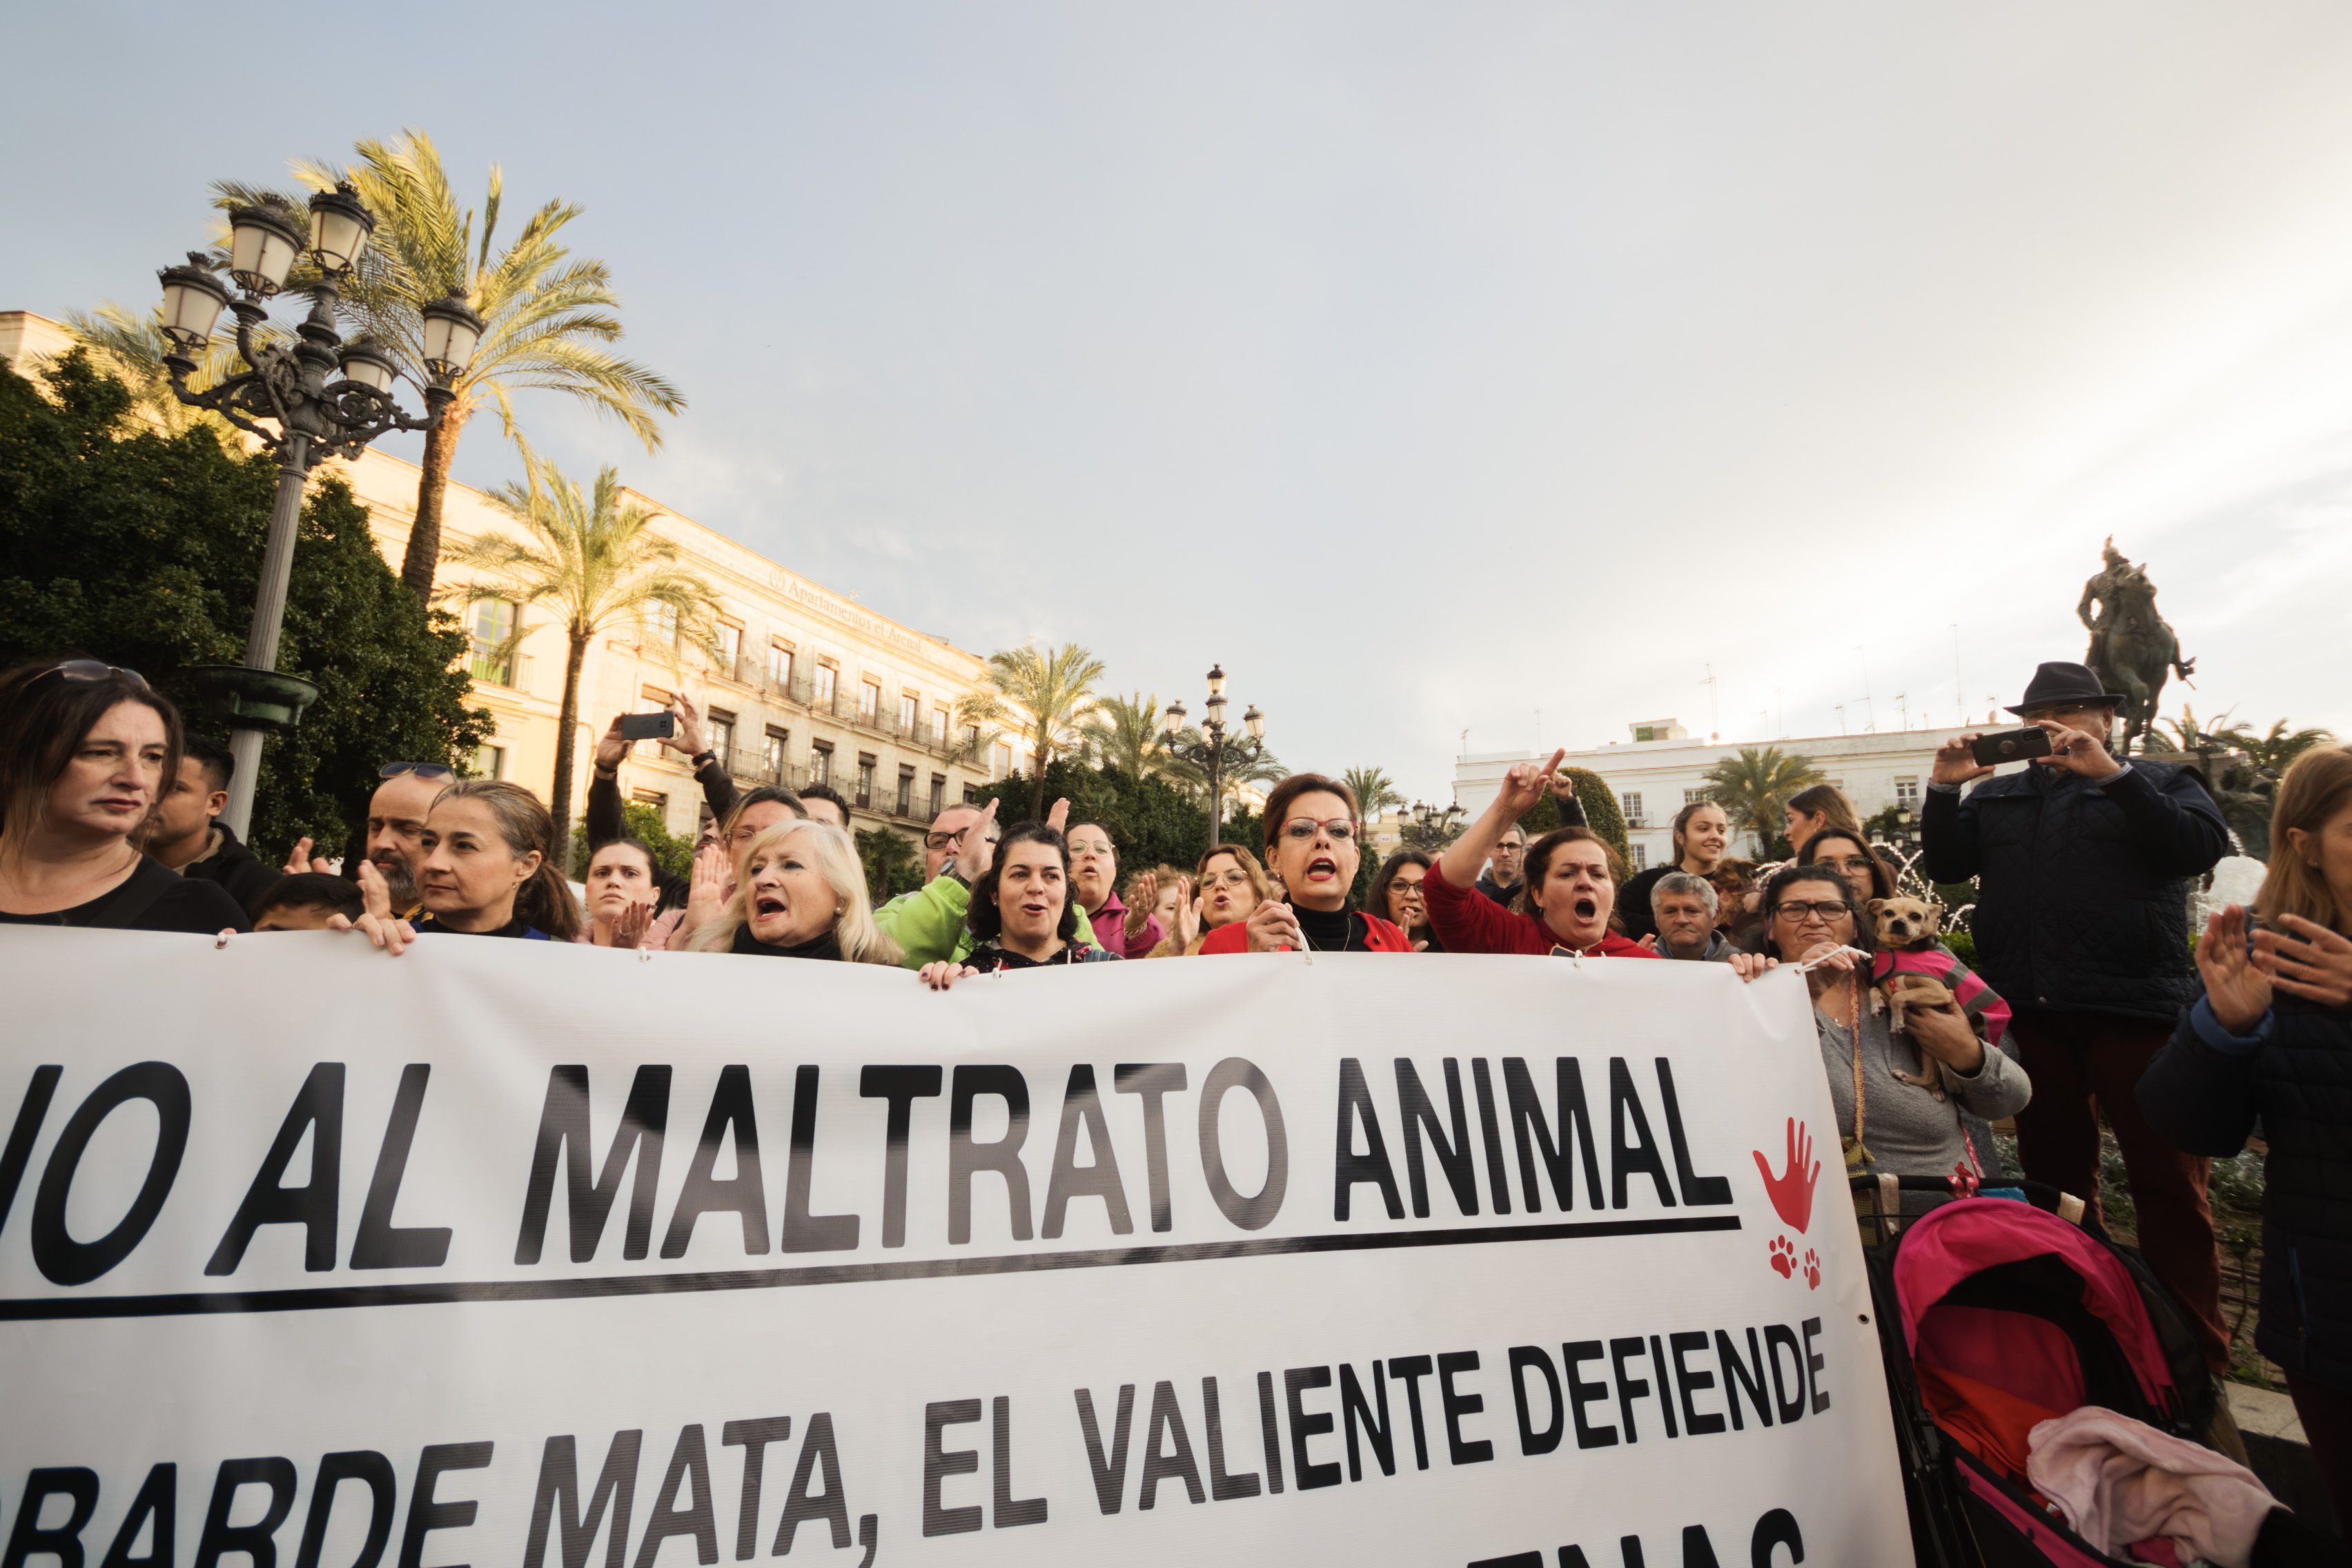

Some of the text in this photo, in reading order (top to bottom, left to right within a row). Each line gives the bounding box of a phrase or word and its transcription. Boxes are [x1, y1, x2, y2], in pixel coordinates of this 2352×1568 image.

[788, 580, 921, 651] Apartamentos el Arenal
[204, 1061, 453, 1277] AL
[514, 1057, 1288, 1265] MALTRATO
[1333, 1057, 1734, 1222] ANIMAL
[522, 1412, 878, 1568] MATA,
[922, 1395, 1048, 1538] EL
[1074, 1350, 1494, 1516] VALIENTE
[1508, 1316, 1831, 1457] DEFIENDE
